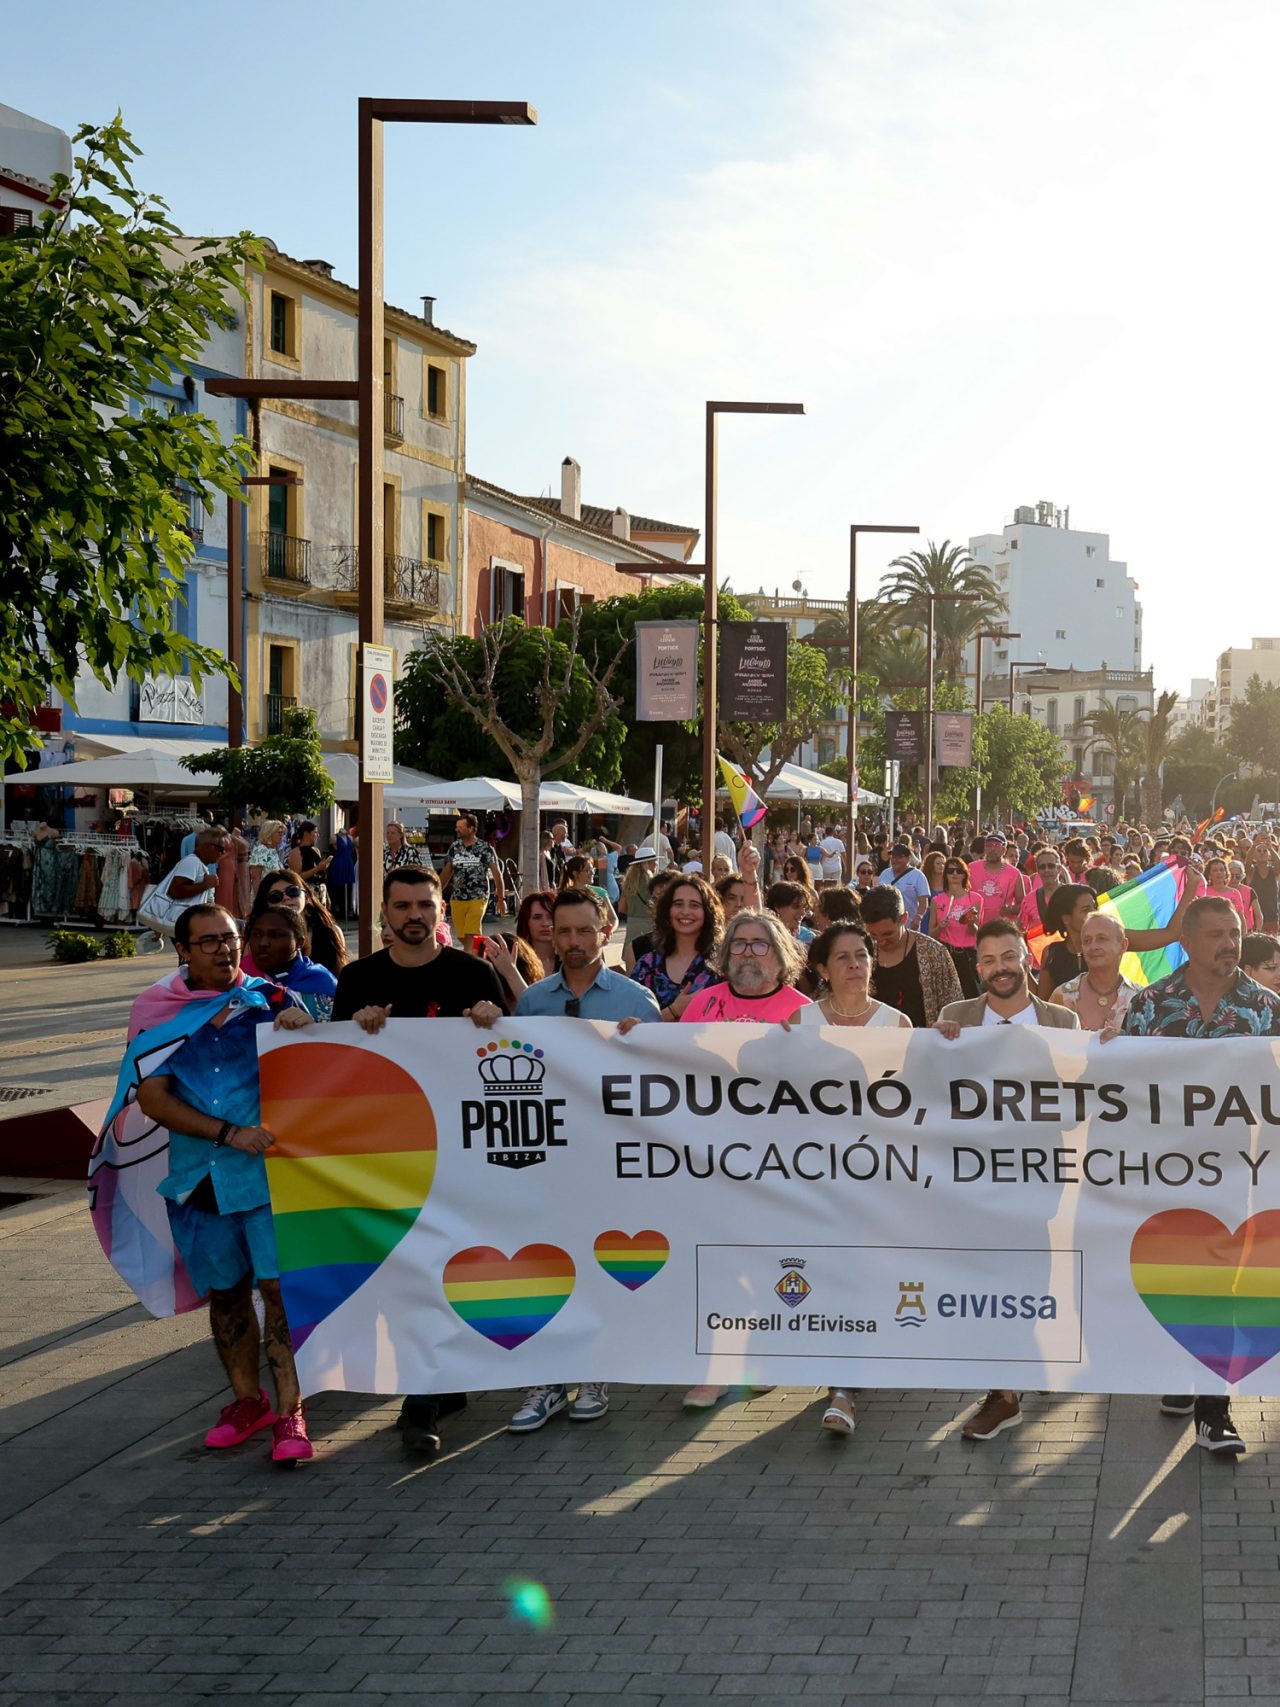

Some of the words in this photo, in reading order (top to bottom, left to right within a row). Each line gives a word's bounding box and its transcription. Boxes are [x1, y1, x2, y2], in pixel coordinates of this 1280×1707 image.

[601, 1070, 928, 1126] EDUCACIÓ,
[949, 1079, 1129, 1123] DRETS
[1149, 1083, 1161, 1125] I
[461, 1098, 568, 1149] PRIDE
[492, 1153, 542, 1162] IBIZA
[615, 1134, 934, 1190] EDUCACIÓN,
[952, 1146, 1224, 1187] DERECHOS
[1238, 1150, 1271, 1187] Y
[706, 1312, 782, 1332] Consell
[788, 1313, 878, 1333] d'Eivissa
[937, 1292, 1058, 1320] eivissa
